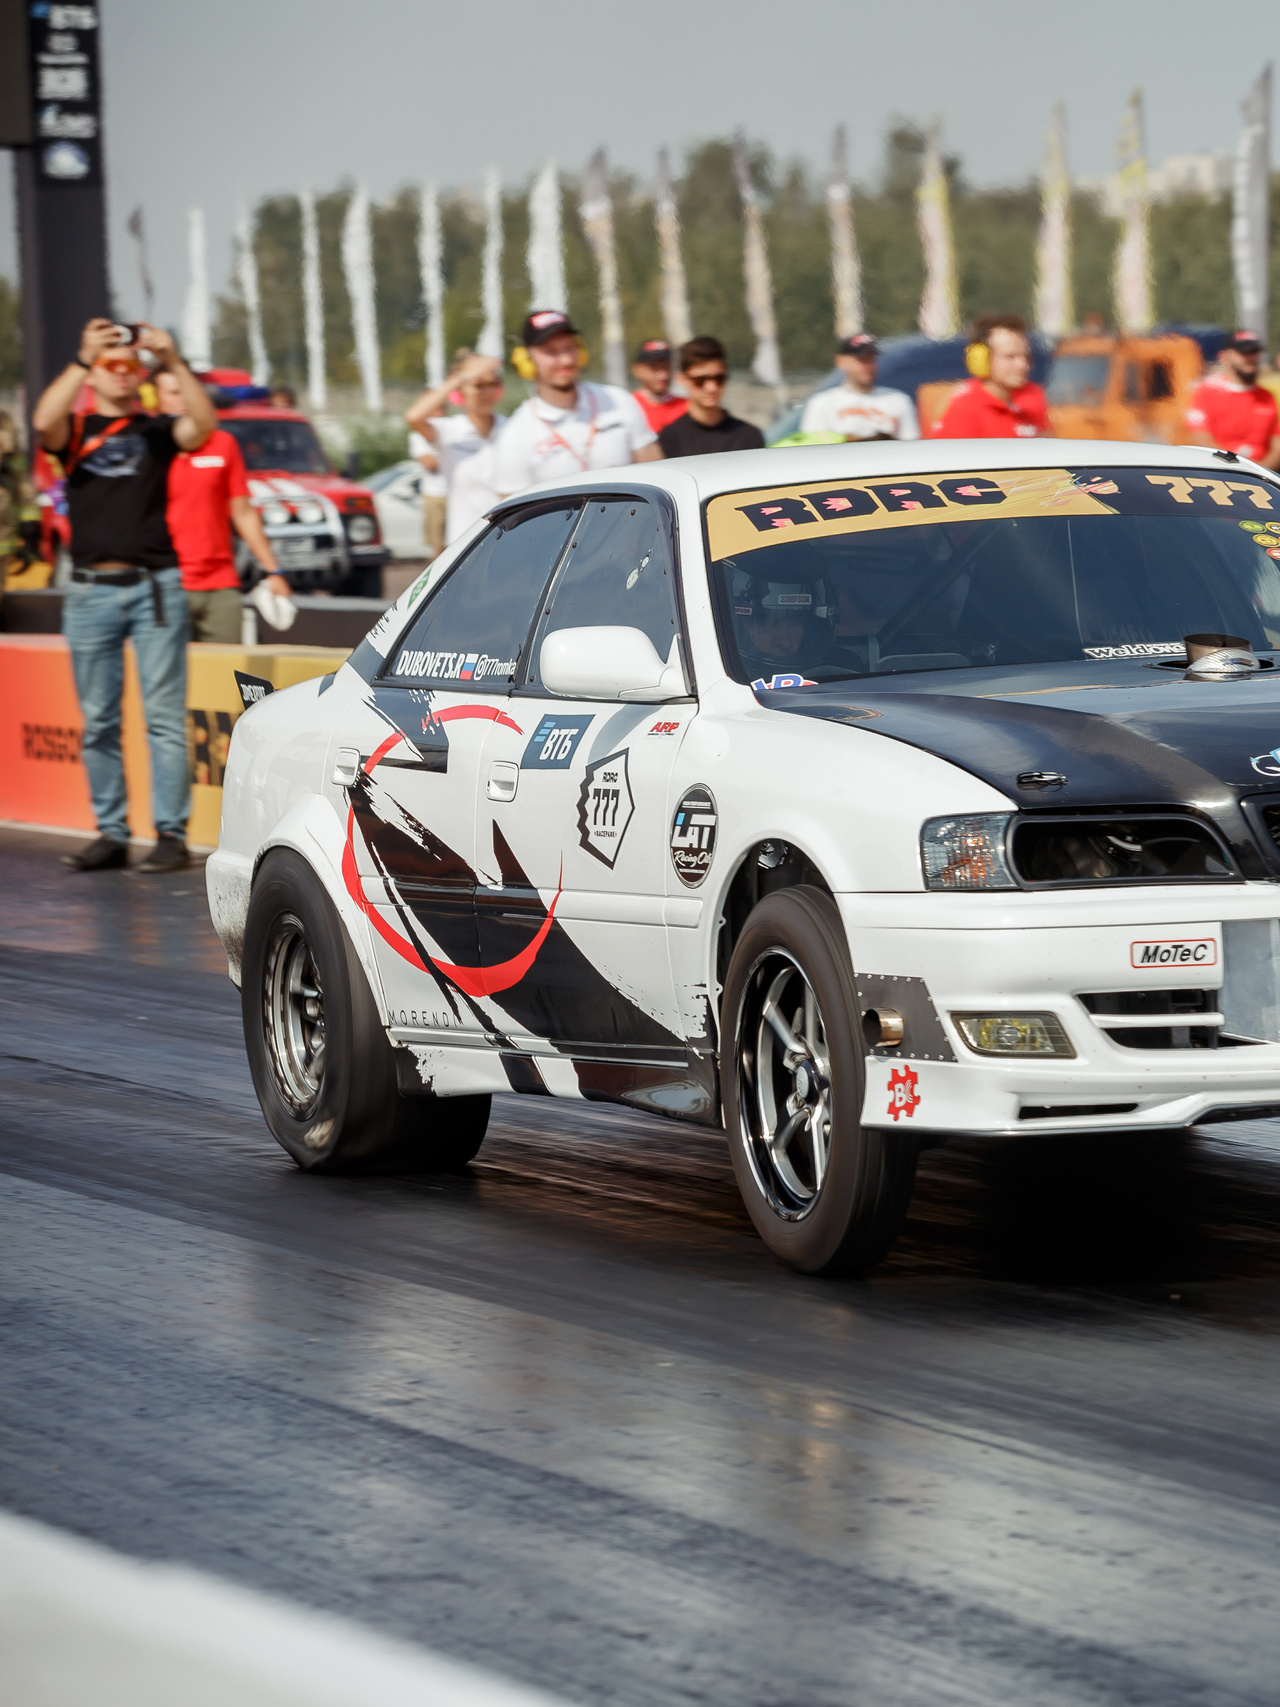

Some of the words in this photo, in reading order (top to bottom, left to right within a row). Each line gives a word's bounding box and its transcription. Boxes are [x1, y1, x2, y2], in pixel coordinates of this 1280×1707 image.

[734, 478, 1007, 532] RDRC
[1144, 474, 1274, 510] 777
[396, 650, 466, 680] DUBOVETS.R
[650, 721, 680, 733] ARP
[539, 729, 580, 761] ВТБ
[602, 771, 619, 783] RDRC
[592, 788, 620, 827] 777
[671, 813, 717, 849] LAT
[674, 850, 698, 868] Racing
[1140, 943, 1208, 963] MoTeC
